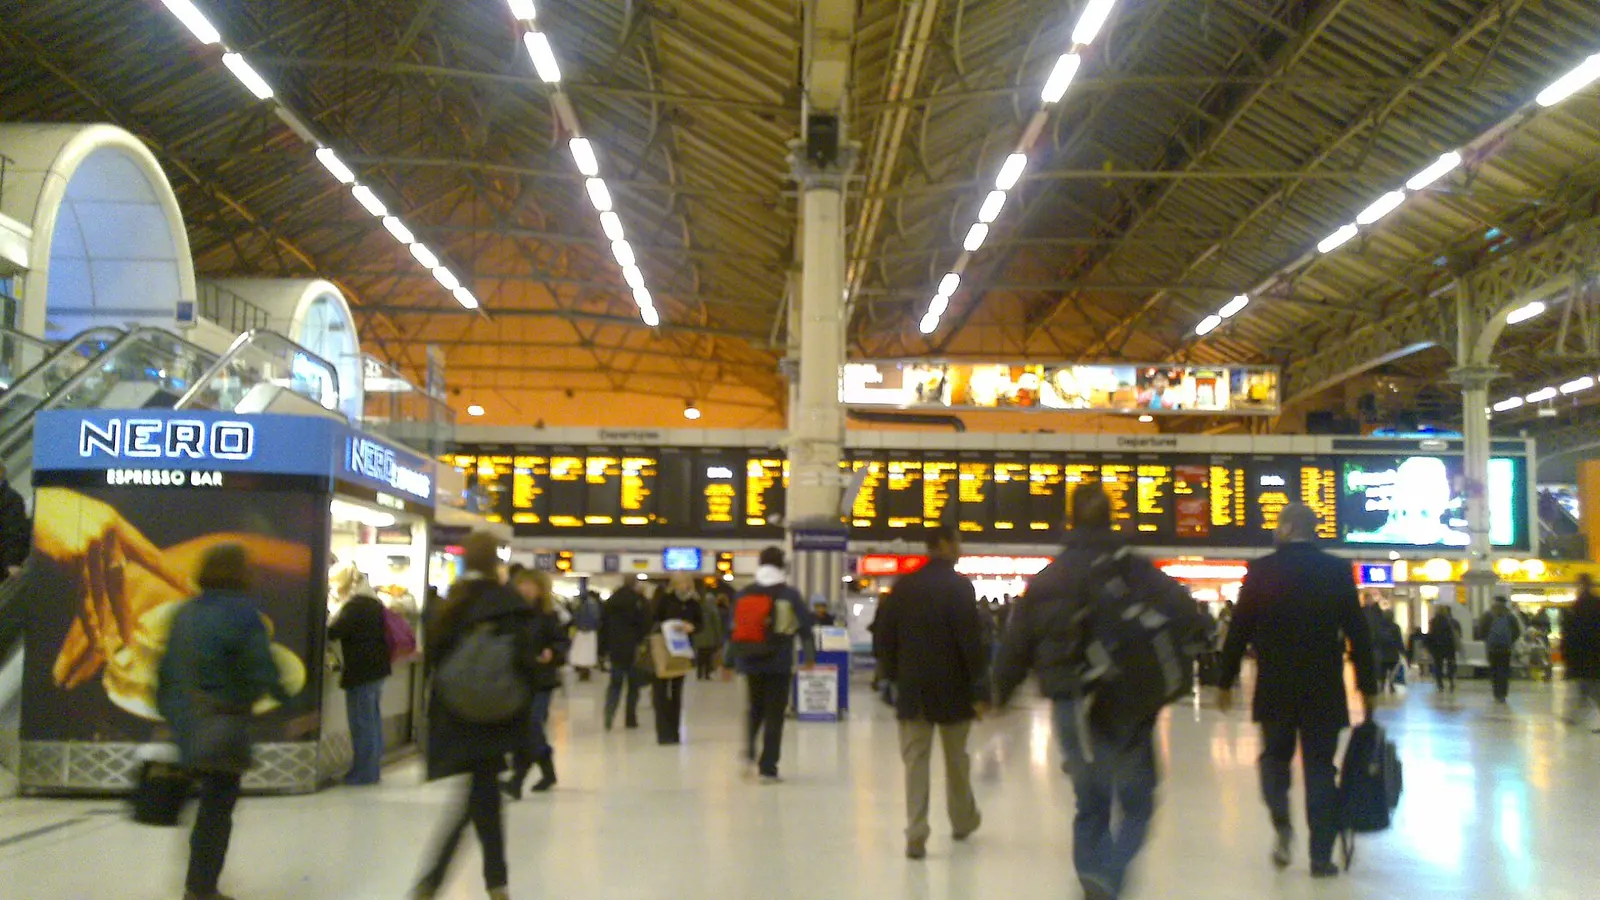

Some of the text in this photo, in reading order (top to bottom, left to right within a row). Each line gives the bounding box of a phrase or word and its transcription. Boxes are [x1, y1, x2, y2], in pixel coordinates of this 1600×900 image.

[79, 418, 254, 460] NERO
[106, 468, 223, 487] ESPRESSO BAR
